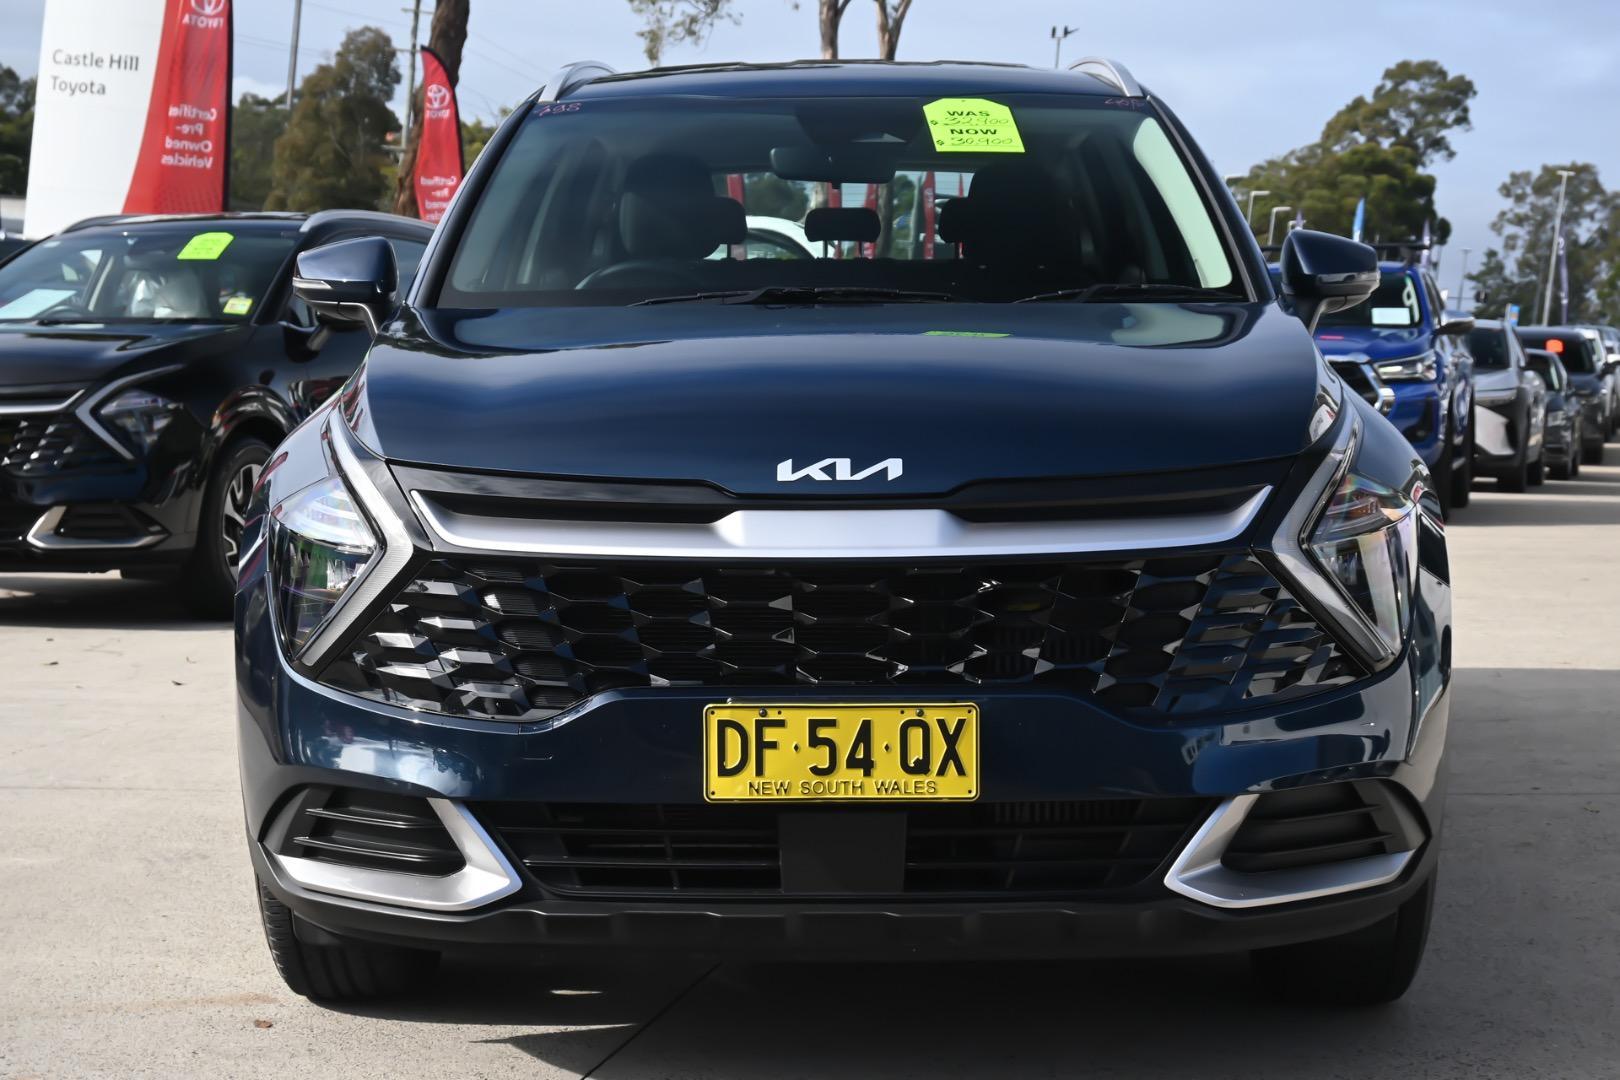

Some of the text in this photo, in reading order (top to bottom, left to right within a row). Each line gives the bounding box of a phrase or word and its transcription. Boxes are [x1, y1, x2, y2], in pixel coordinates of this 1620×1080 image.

[52, 49, 140, 71] Castle Hill
[51, 76, 107, 95] Toyota
[777, 457, 903, 481] KIA
[748, 780, 937, 796] NEW SOUTH WALES
